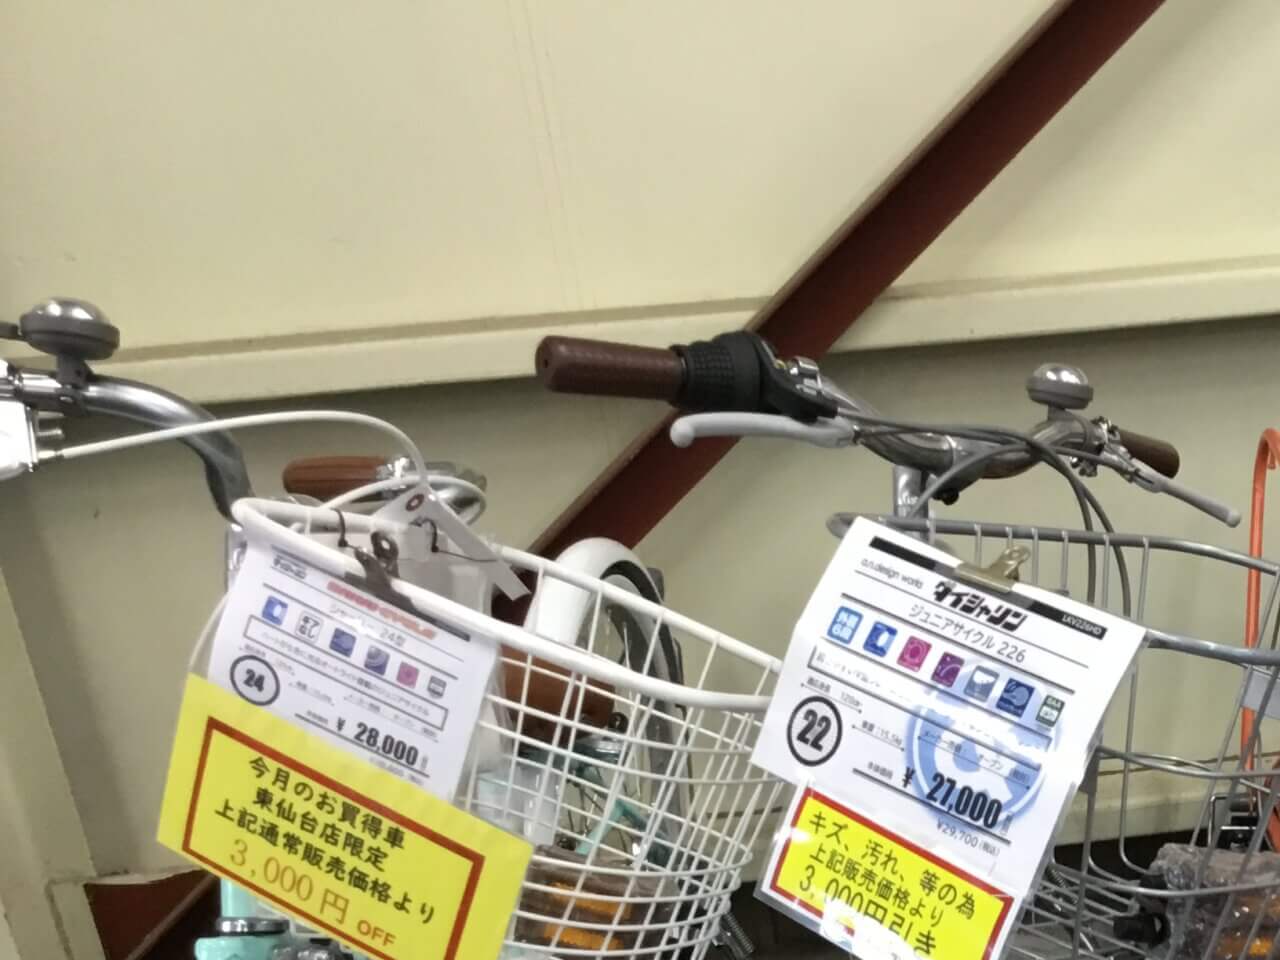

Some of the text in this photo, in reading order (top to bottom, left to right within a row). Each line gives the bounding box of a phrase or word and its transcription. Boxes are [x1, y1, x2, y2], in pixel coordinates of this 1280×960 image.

[909, 603, 1026, 664] ジュニアサイクル 226
[934, 580, 1028, 632] ダイシャリン
[243, 668, 265, 692] 24
[354, 722, 419, 766] 28,000
[797, 709, 831, 752] 22
[250, 756, 405, 849] 今月のお買得車
[902, 767, 914, 788] ¥
[926, 773, 1002, 829] 27,000
[253, 786, 388, 872] 東仙台店限定
[215, 799, 435, 924] 上記通常販売価格より
[810, 843, 944, 928] 上記販売価格より
[357, 919, 396, 947] OFF
